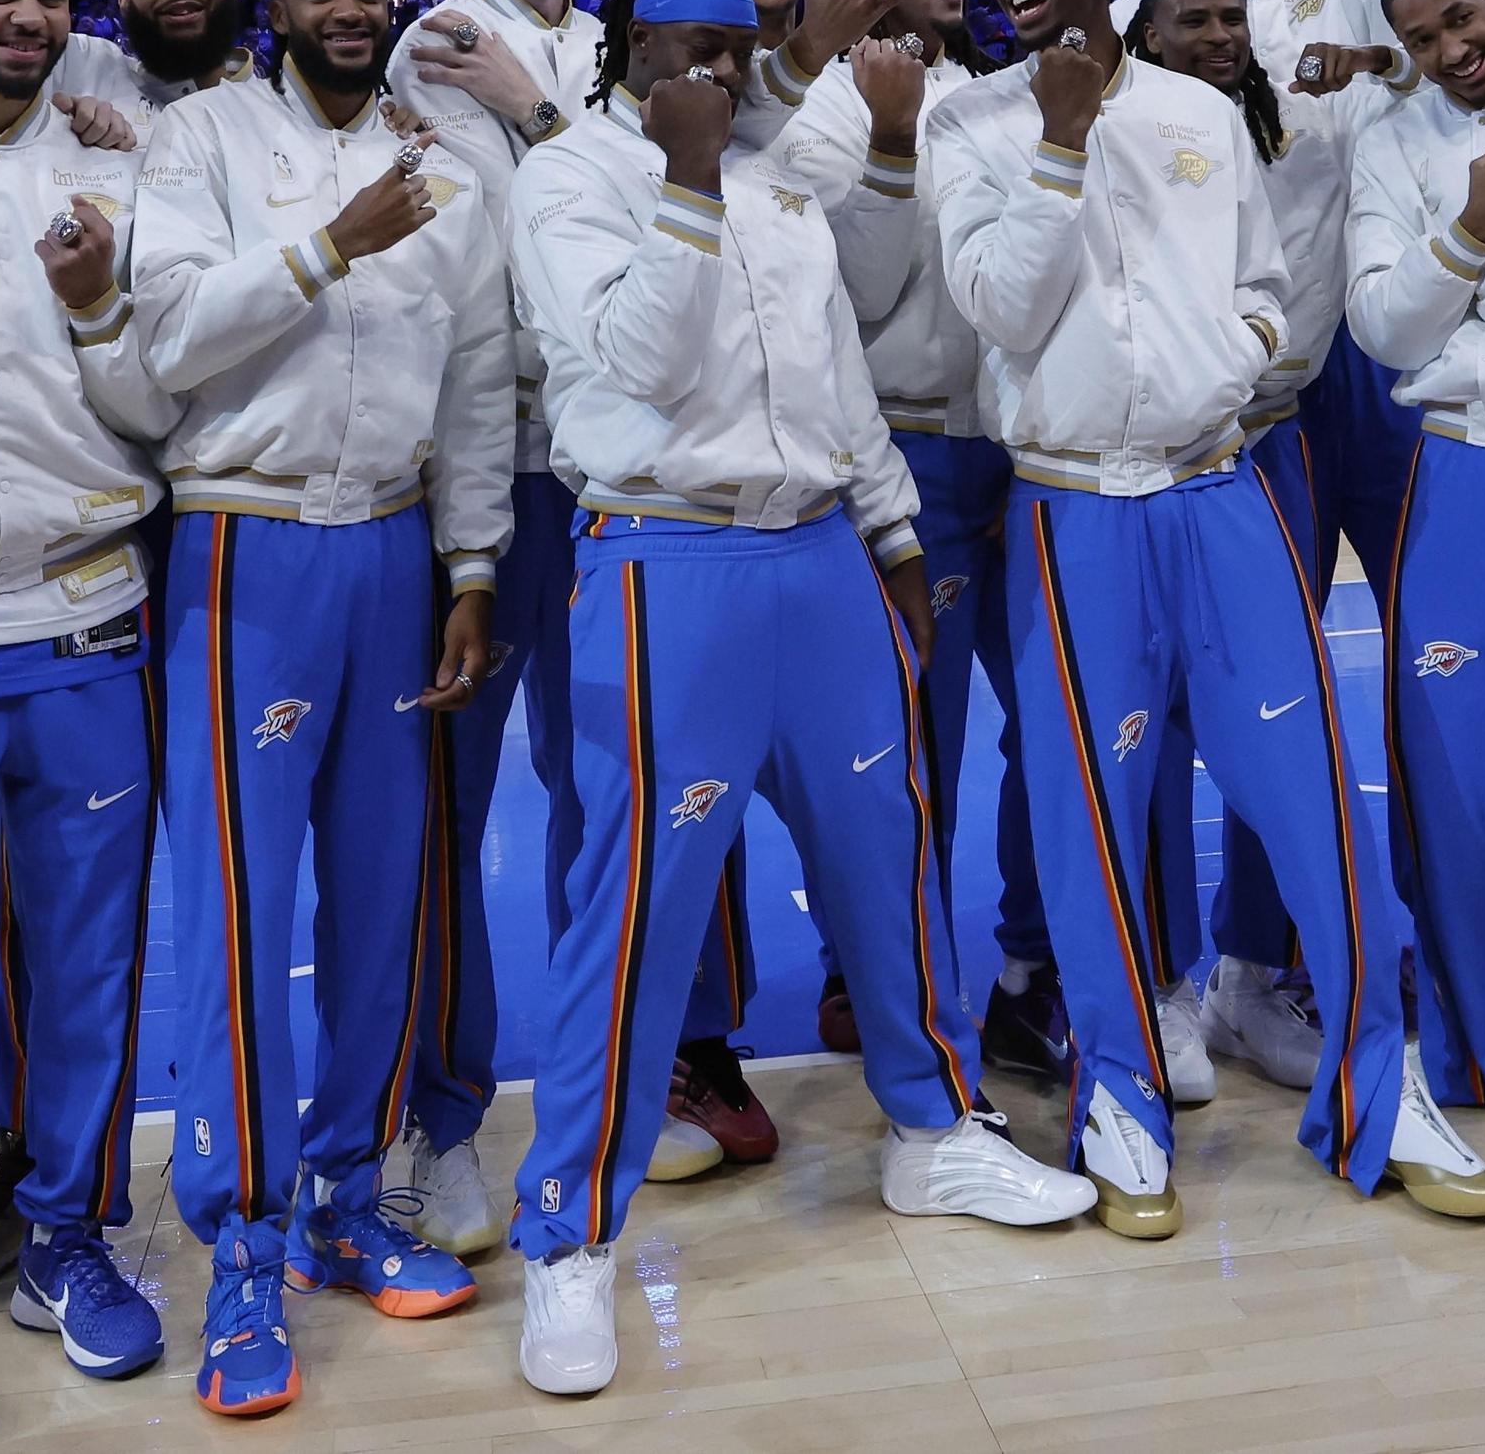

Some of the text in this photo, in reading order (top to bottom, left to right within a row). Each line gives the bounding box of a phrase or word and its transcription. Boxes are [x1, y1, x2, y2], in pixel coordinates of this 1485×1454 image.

[156, 177, 184, 187] BANK
[1427, 649, 1457, 667] OKC
[269, 710, 296, 735] OKC
[685, 788, 713, 816] OKC
